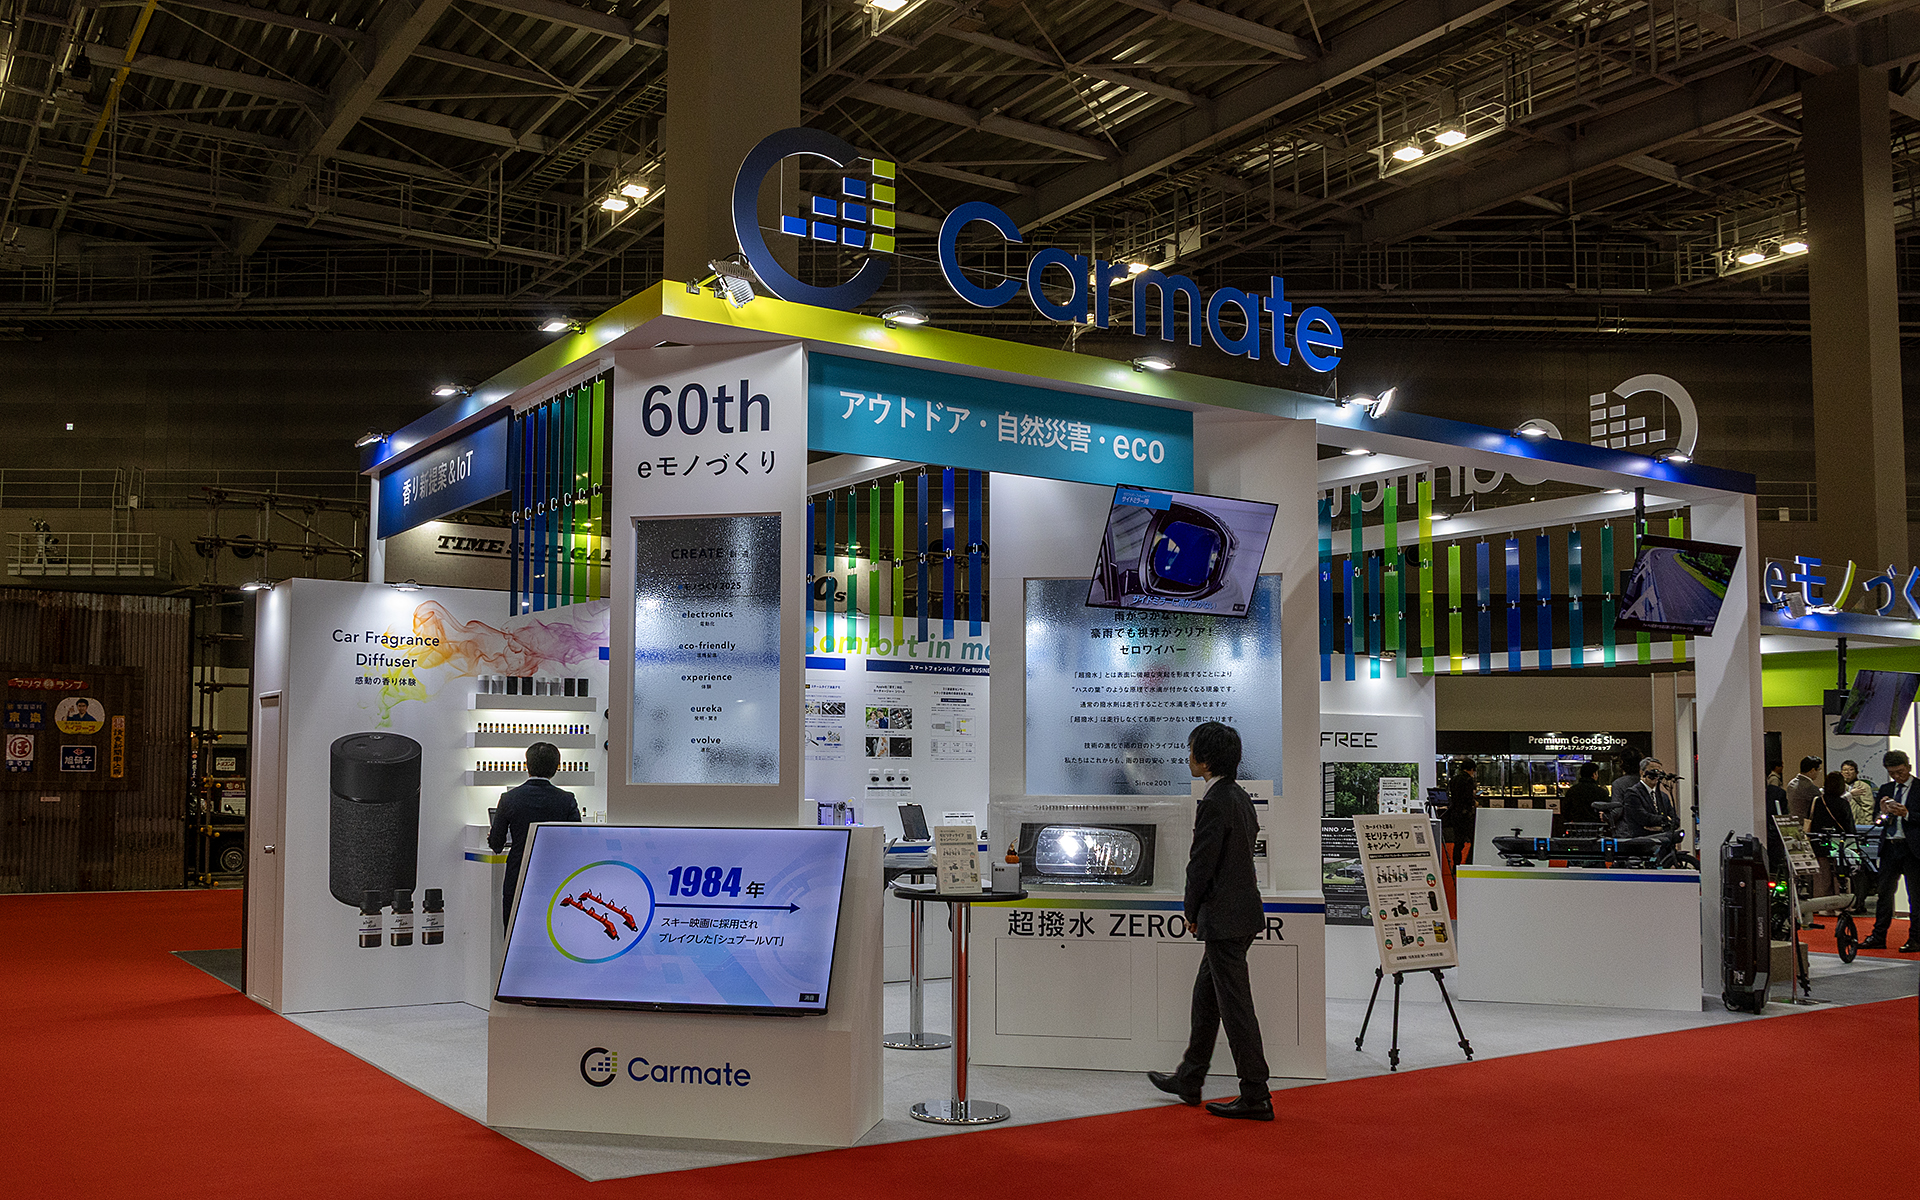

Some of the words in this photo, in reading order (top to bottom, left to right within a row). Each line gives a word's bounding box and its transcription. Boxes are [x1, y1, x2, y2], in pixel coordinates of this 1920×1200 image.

[938, 201, 1343, 372] Carmate
[641, 379, 770, 437] 60th
[839, 390, 1165, 465] アウトドア・自然災害・eco
[637, 450, 775, 479] eモノづくり
[437, 535, 505, 553] TIME
[671, 548, 724, 560] CREATE
[681, 609, 734, 619] electronics
[332, 629, 359, 643] Car
[365, 631, 440, 648] Fragrance
[678, 641, 736, 651] eco-friendly
[927, 633, 950, 659] in
[356, 653, 417, 667] Diffuser
[355, 676, 417, 687] 感動の香り体験
[681, 672, 733, 683] experience
[690, 704, 723, 713] eureka
[690, 736, 721, 745] evolve
[1320, 731, 1378, 749] FREE
[1528, 735, 1570, 745] Premium
[1571, 736, 1602, 745] Goods
[1603, 736, 1628, 747] Shop
[1365, 831, 1410, 841] モビリティライフ
[1367, 842, 1401, 851] キャンペーン
[667, 865, 743, 897] 1984
[745, 881, 766, 899] 年
[661, 918, 759, 930] スキー映画に採用され
[1007, 909, 1095, 938] 超撥水
[658, 933, 785, 947] ブレイクした「シュプールVT」
[627, 1056, 751, 1087] Carmate
